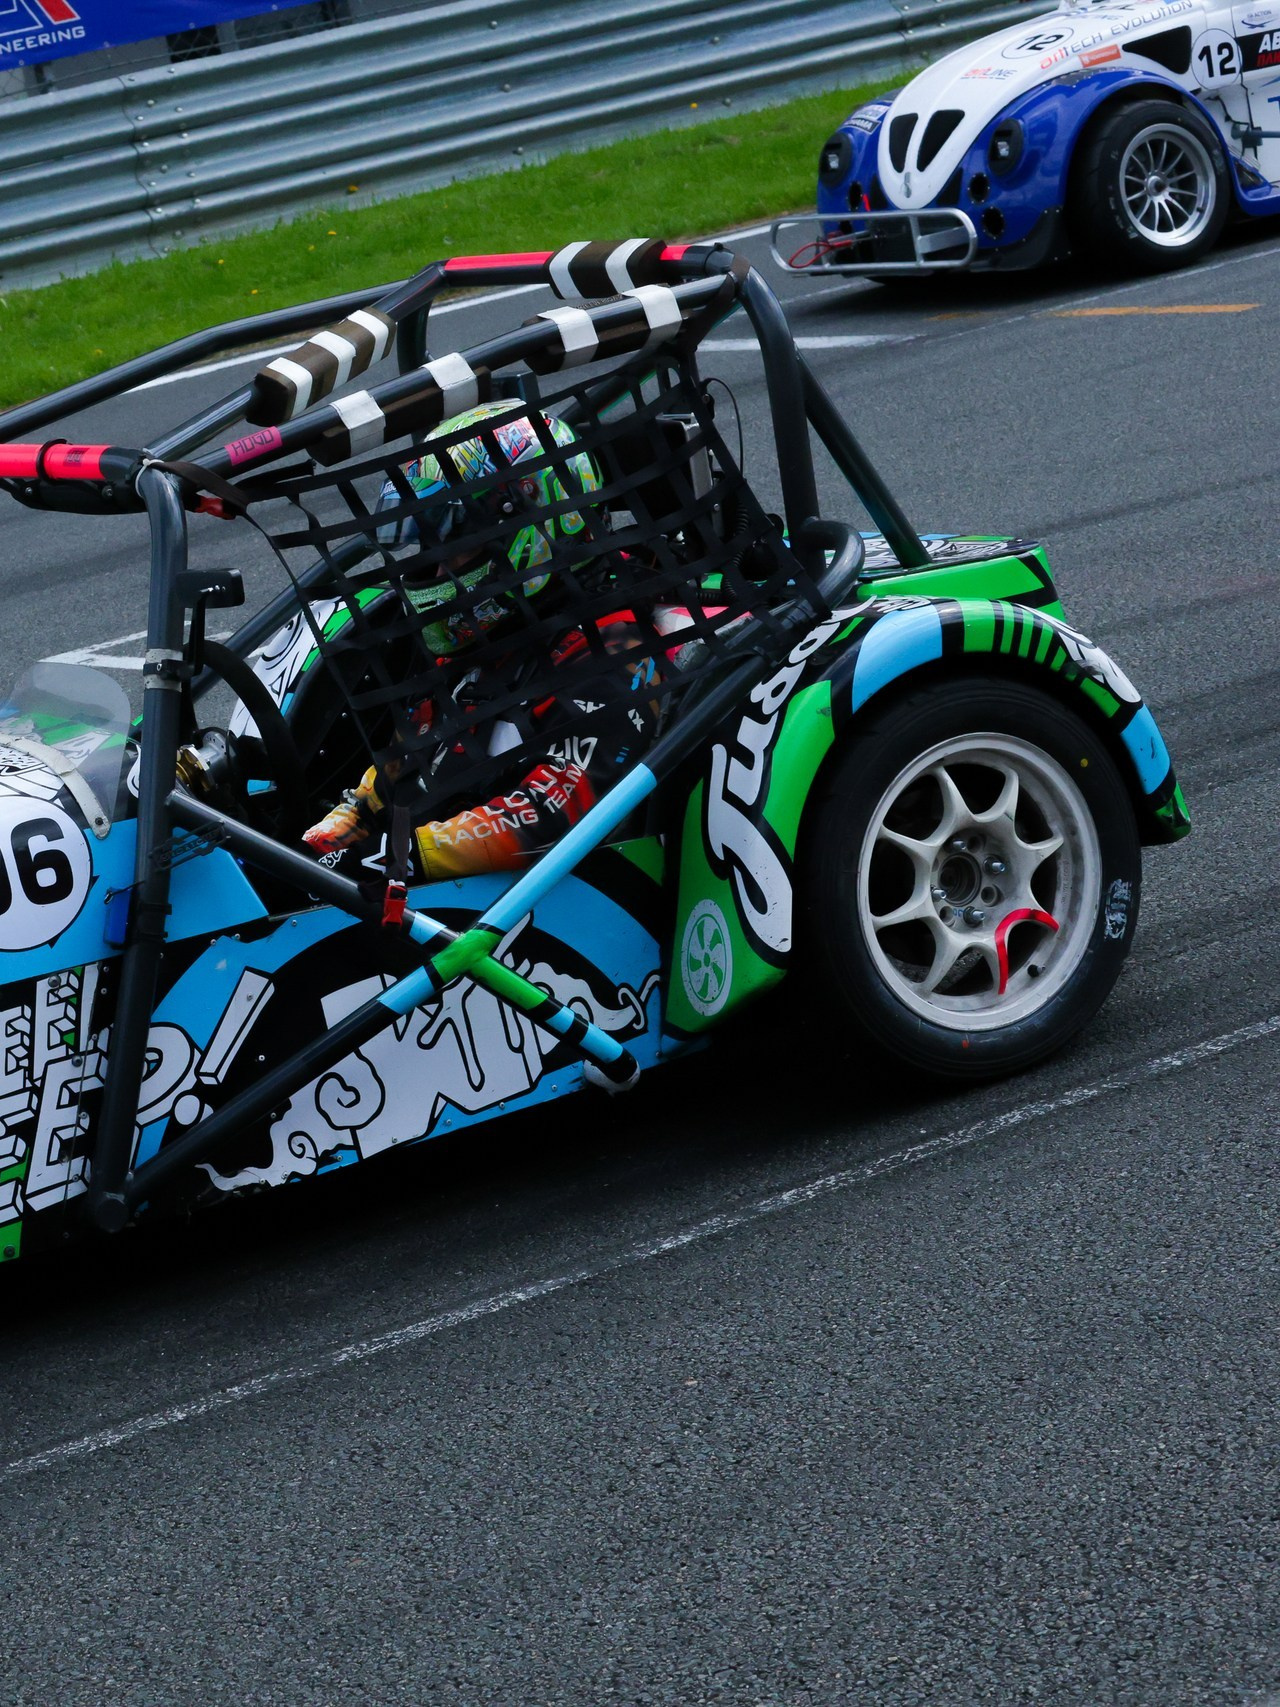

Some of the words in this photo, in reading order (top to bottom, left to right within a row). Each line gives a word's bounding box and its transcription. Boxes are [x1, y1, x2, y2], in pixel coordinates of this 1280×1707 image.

[1111, 0, 1193, 35] EVOLUTION
[1016, 34, 1064, 51] 12
[1198, 42, 1237, 78] 12
[432, 808, 539, 848] RACING
[543, 764, 586, 814] TEAM
